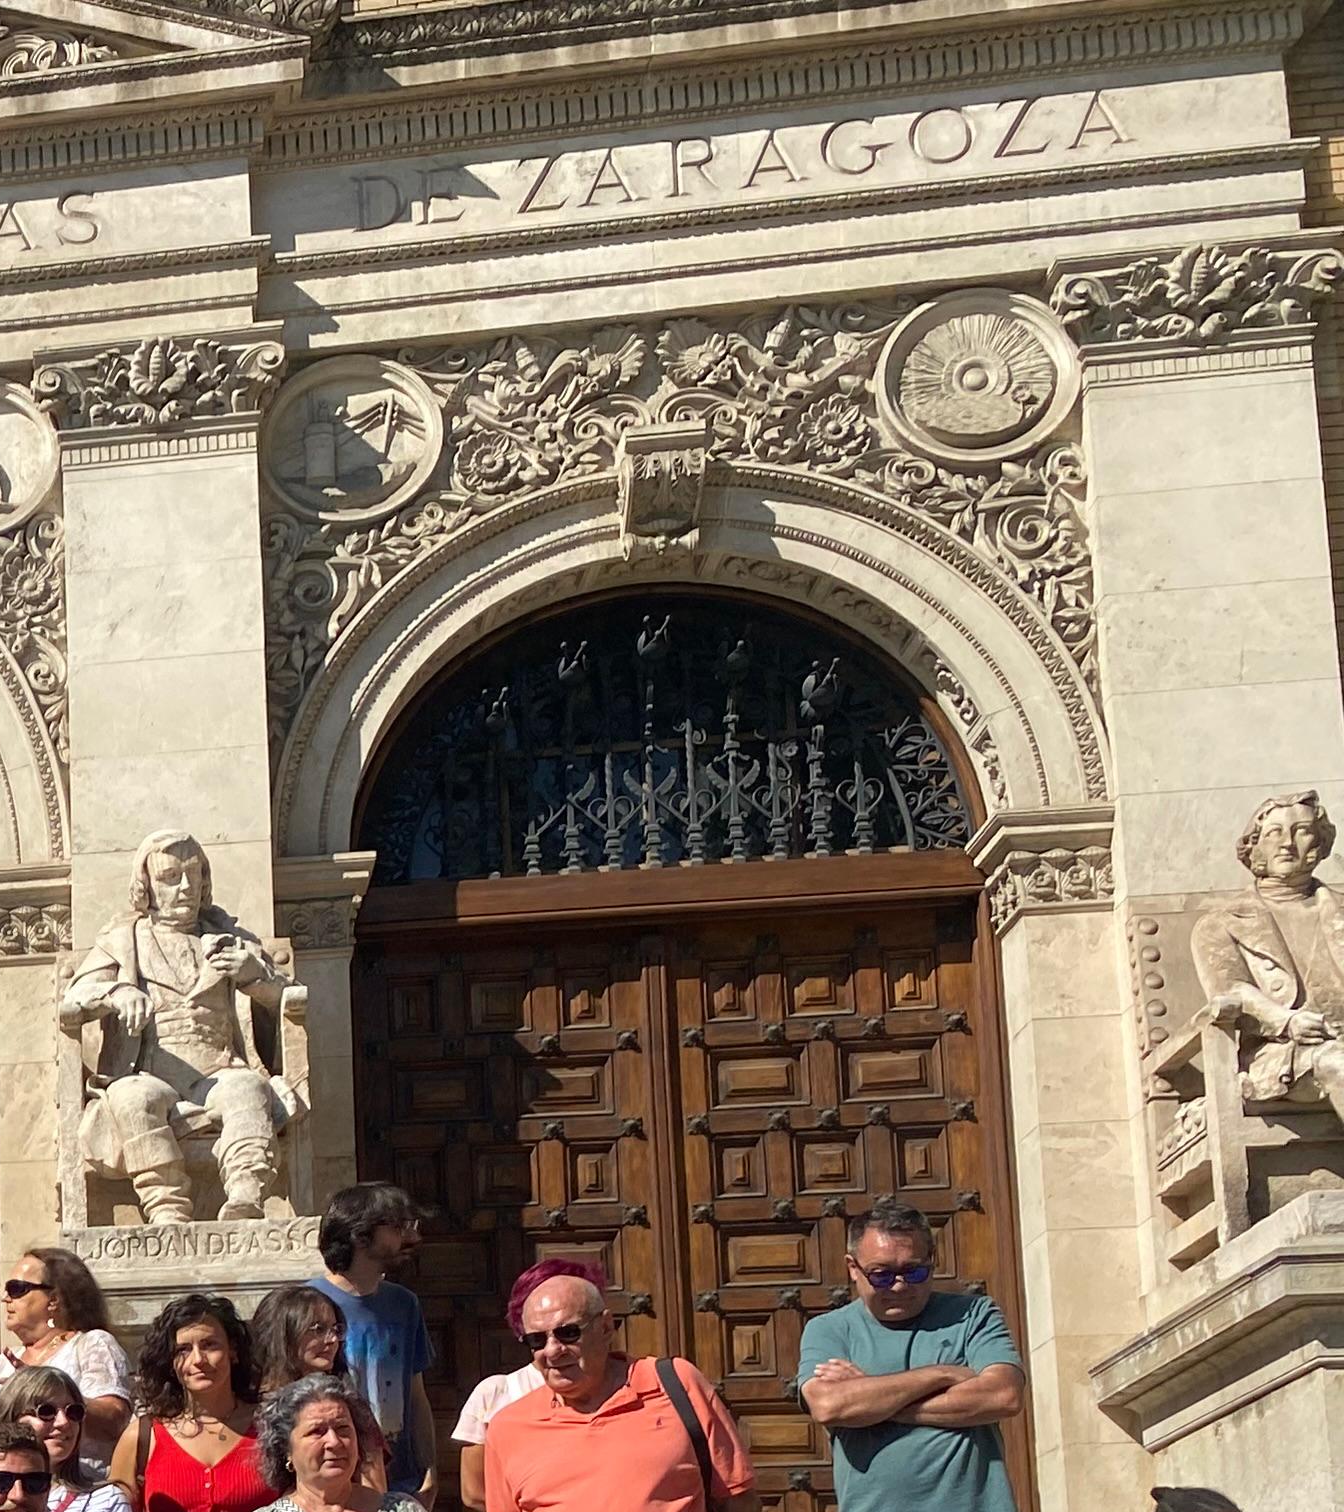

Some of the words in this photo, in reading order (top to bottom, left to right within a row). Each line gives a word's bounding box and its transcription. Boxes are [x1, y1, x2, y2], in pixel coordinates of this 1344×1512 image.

[350, 164, 466, 232] DE
[514, 87, 1140, 216] ZARAGOZA
[206, 1230, 241, 1257] DE
